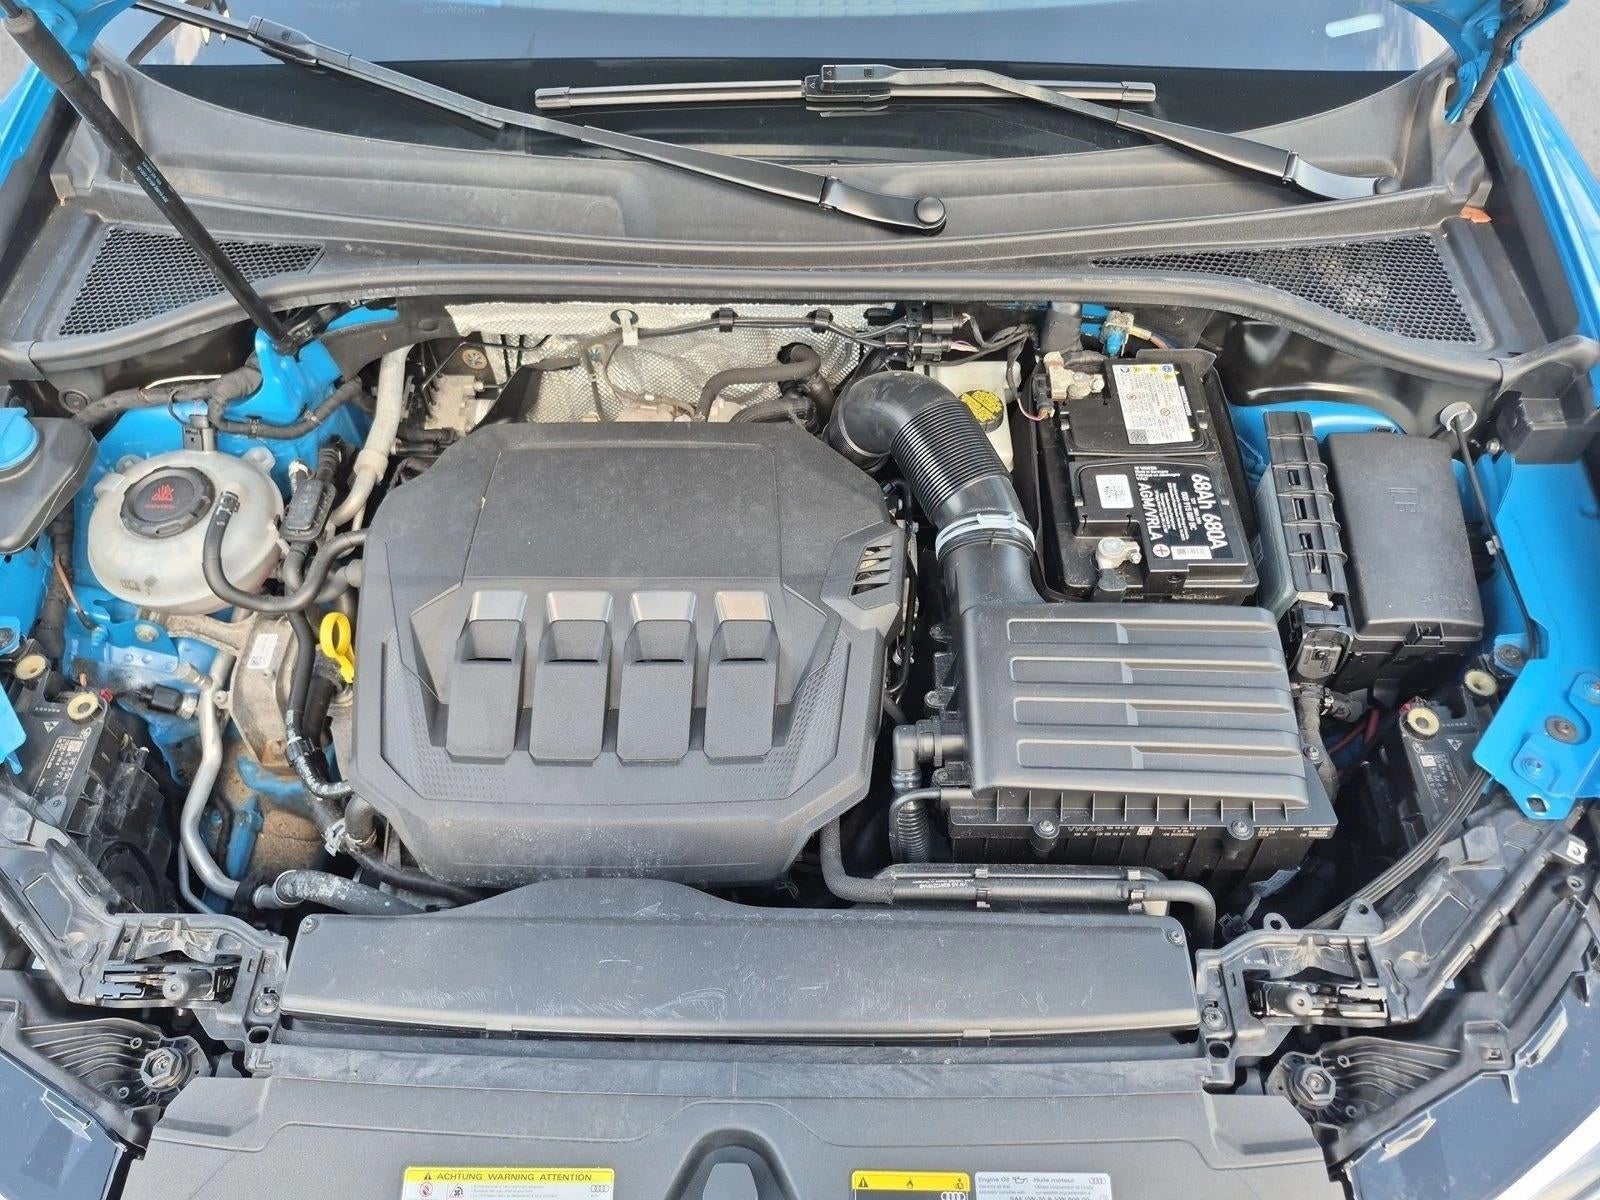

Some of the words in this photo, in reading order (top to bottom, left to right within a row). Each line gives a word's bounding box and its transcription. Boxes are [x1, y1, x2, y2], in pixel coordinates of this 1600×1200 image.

[1191, 473, 1216, 509] 68Ah
[1138, 482, 1163, 540] AGM/VRLA
[1201, 513, 1228, 549] 680A
